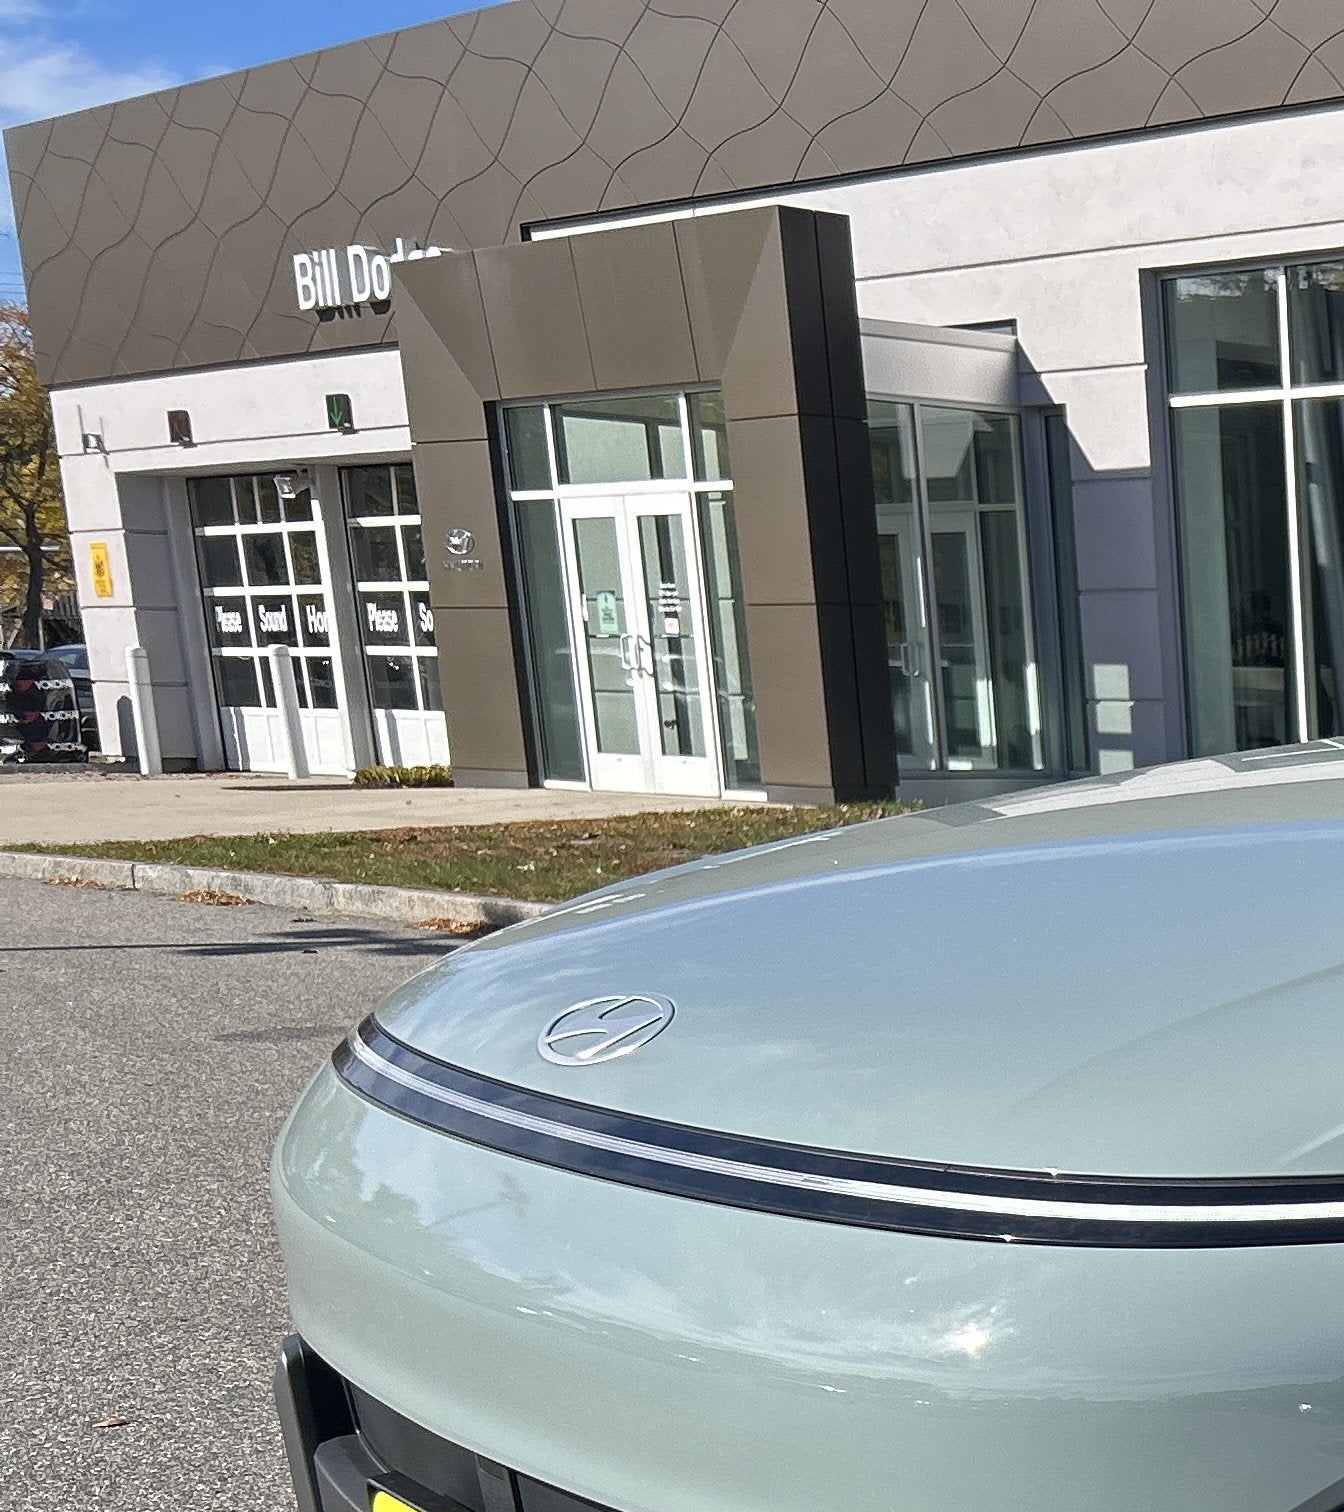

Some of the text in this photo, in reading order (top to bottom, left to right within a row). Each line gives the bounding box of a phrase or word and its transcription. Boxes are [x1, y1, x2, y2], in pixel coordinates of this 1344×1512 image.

[293, 248, 342, 310] Bill
[258, 603, 288, 633] Sound
[365, 601, 399, 633] Please
